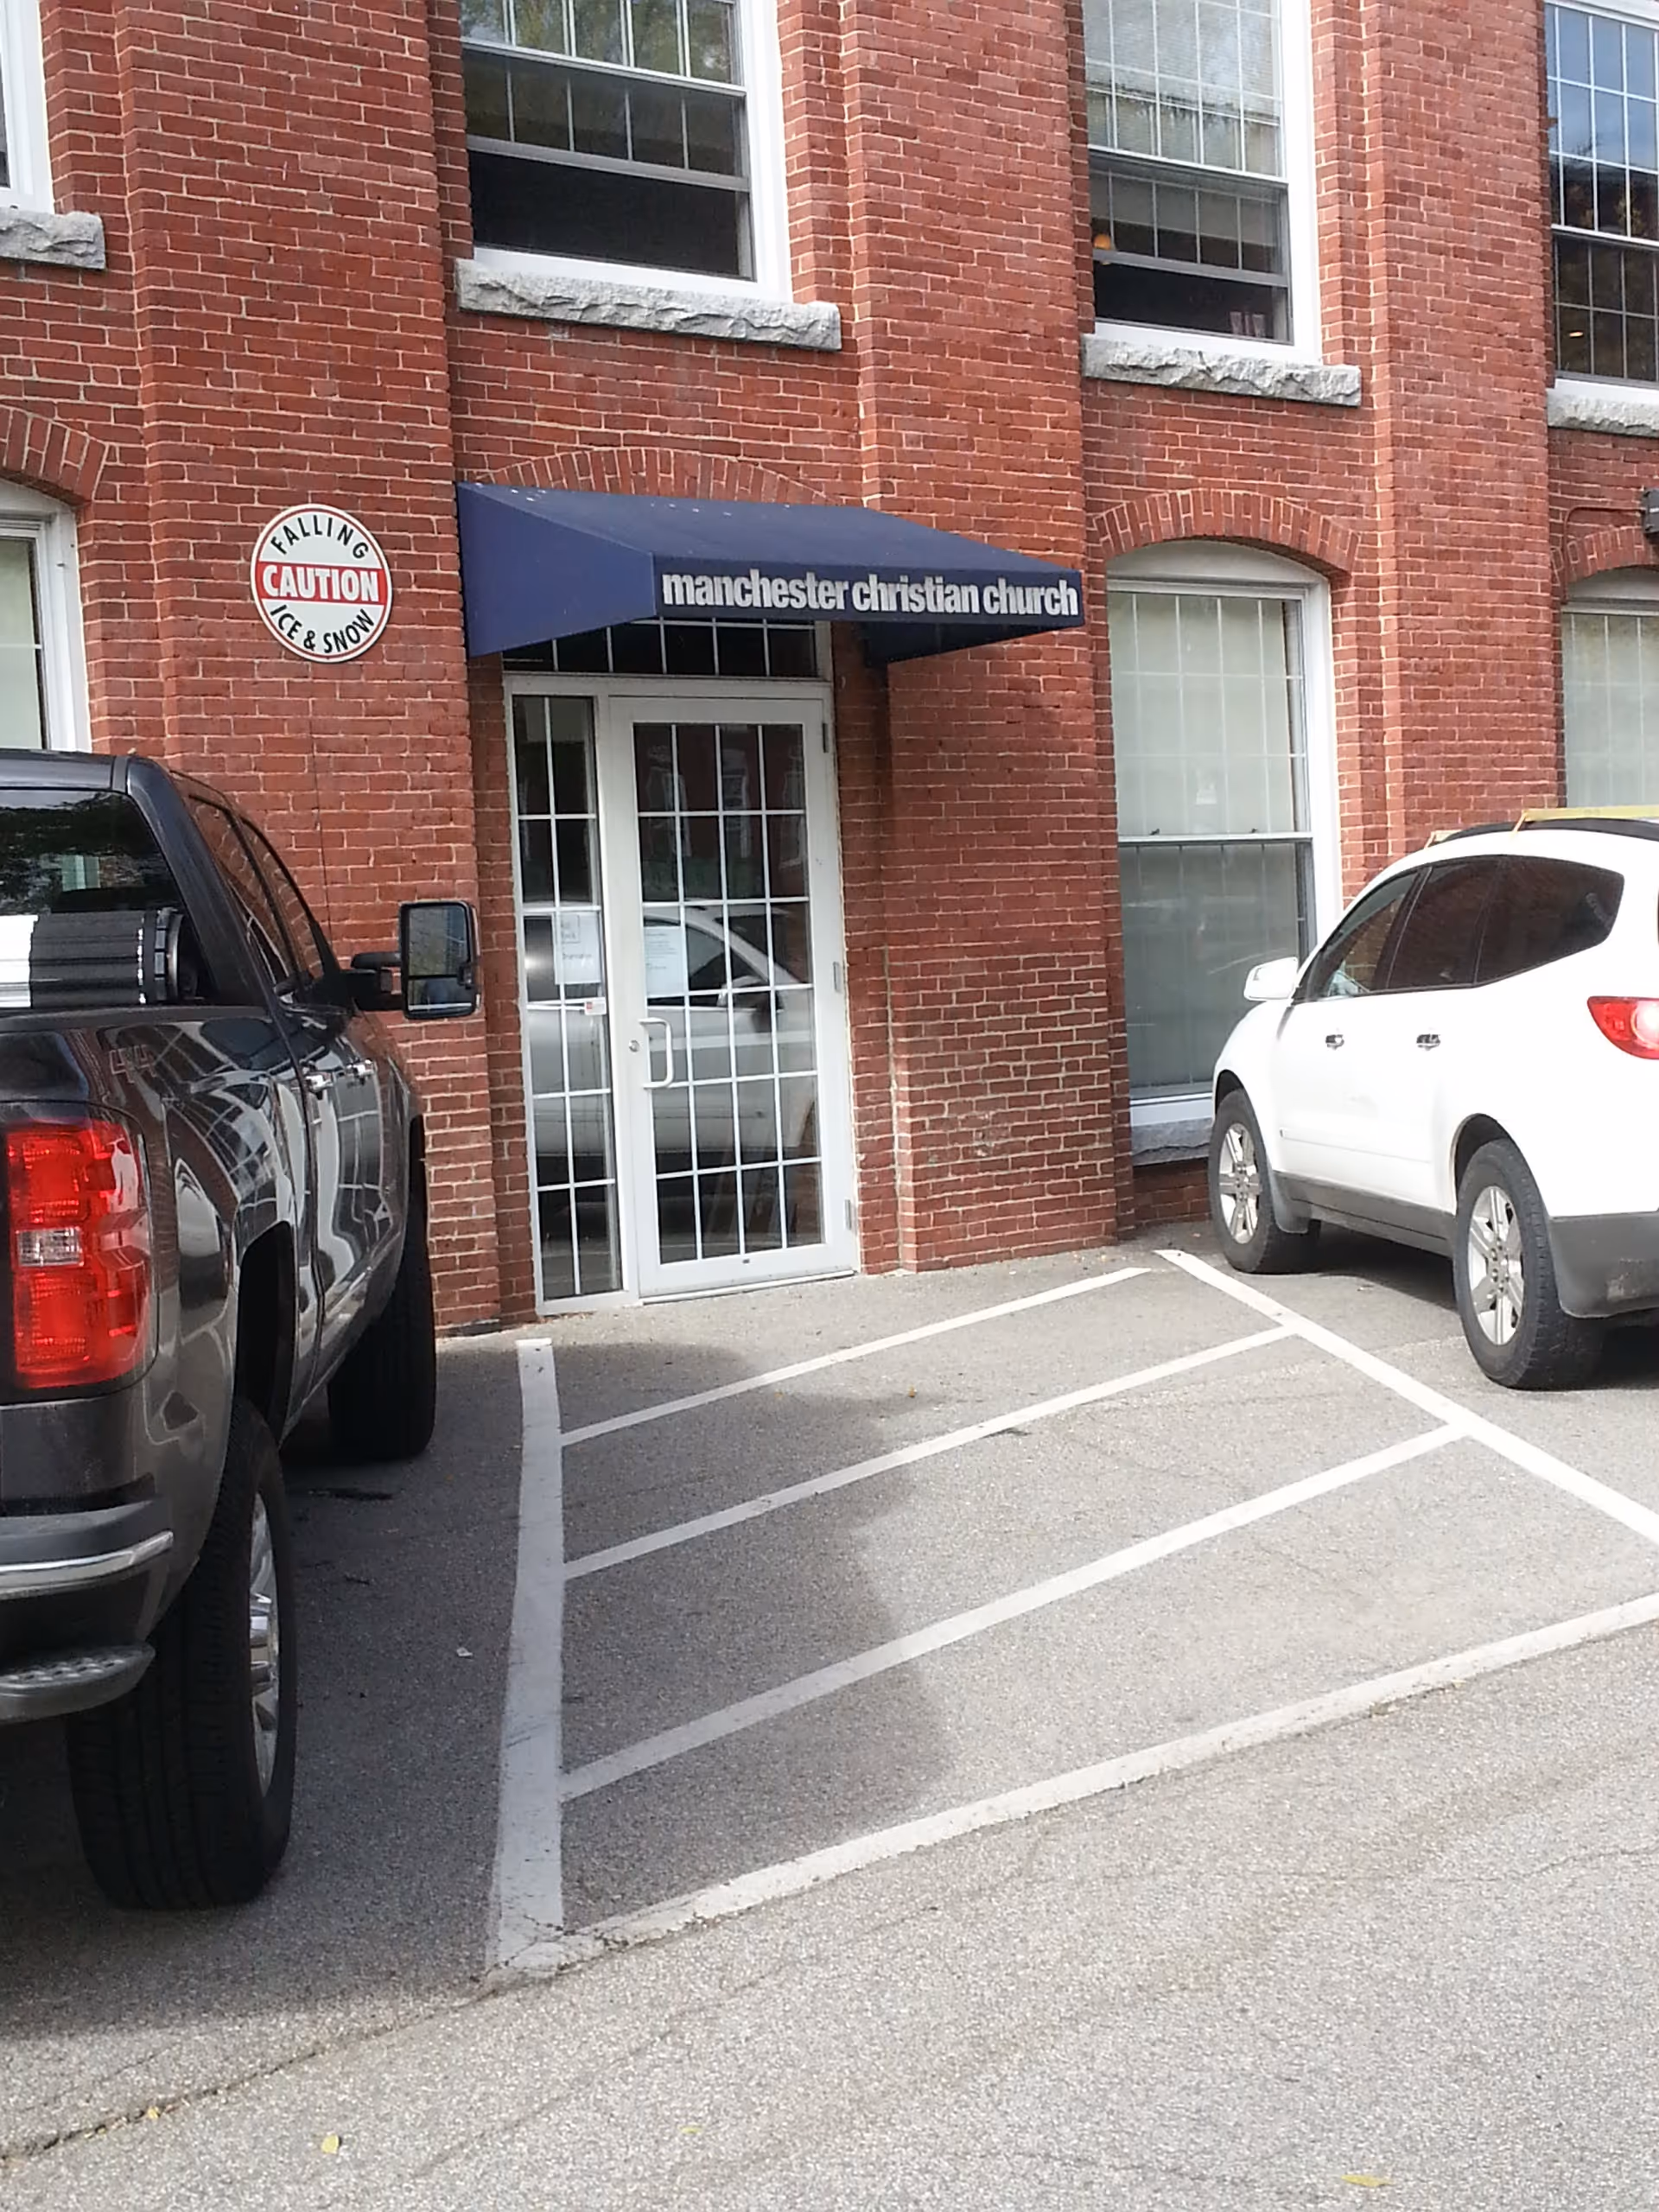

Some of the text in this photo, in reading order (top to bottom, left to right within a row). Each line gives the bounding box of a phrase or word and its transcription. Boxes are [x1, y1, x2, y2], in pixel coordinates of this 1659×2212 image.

[270, 515, 369, 559] FALLING
[263, 564, 379, 602] CAUTION
[662, 569, 1078, 615] manchester christian church
[270, 605, 375, 653] ICE & SNOW
